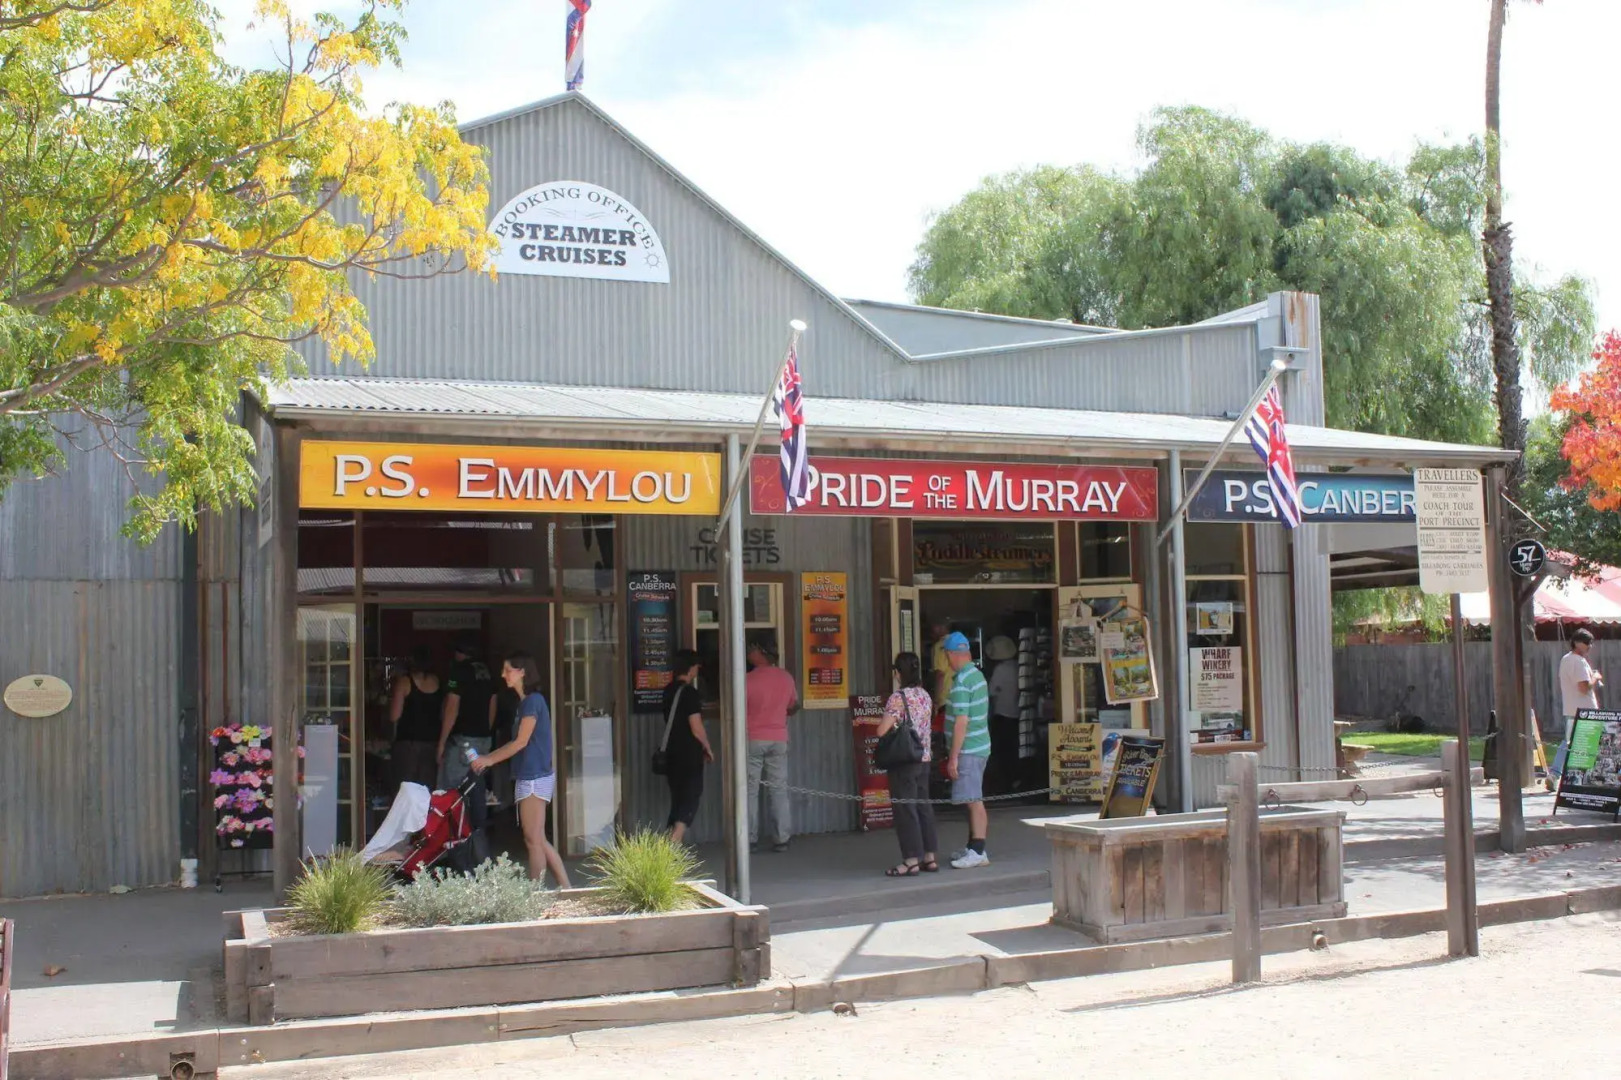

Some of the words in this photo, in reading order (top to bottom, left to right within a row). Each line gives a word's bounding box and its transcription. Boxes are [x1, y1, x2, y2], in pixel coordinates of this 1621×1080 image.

[495, 187, 581, 239] BOOKING
[587, 190, 655, 250] OFFICE
[511, 222, 636, 247] STEAMER
[519, 244, 627, 267] CRUISES
[333, 454, 430, 498] P.S.
[457, 457, 692, 504] EMMYLOU
[1417, 469, 1479, 481] TRAVELLERS
[928, 475, 951, 491] OF
[965, 469, 1127, 513] MURRAY
[1424, 484, 1443, 492] PLEASE
[923, 492, 957, 509] THE
[1224, 479, 1273, 514] P.S
[1296, 481, 1416, 516] CANBER
[1423, 502, 1449, 511] COACH
[1452, 502, 1474, 511] TOUR
[1419, 517, 1438, 526] PORT
[1443, 517, 1480, 527] PRECINCT
[698, 528, 776, 545] CISE
[690, 546, 780, 564] TICETS
[1517, 545, 1536, 563] 57
[643, 574, 662, 583] P.S.
[628, 582, 677, 591] CANBERRA
[1201, 648, 1232, 660] WHARF
[1202, 660, 1232, 671] WINERY
[1200, 672, 1213, 681] $75
[1213, 671, 1235, 680] PACKAGE
[857, 695, 882, 704] PRIDE
[1119, 763, 1152, 778] TICKETS
[1065, 786, 1101, 795] CANBERRA
